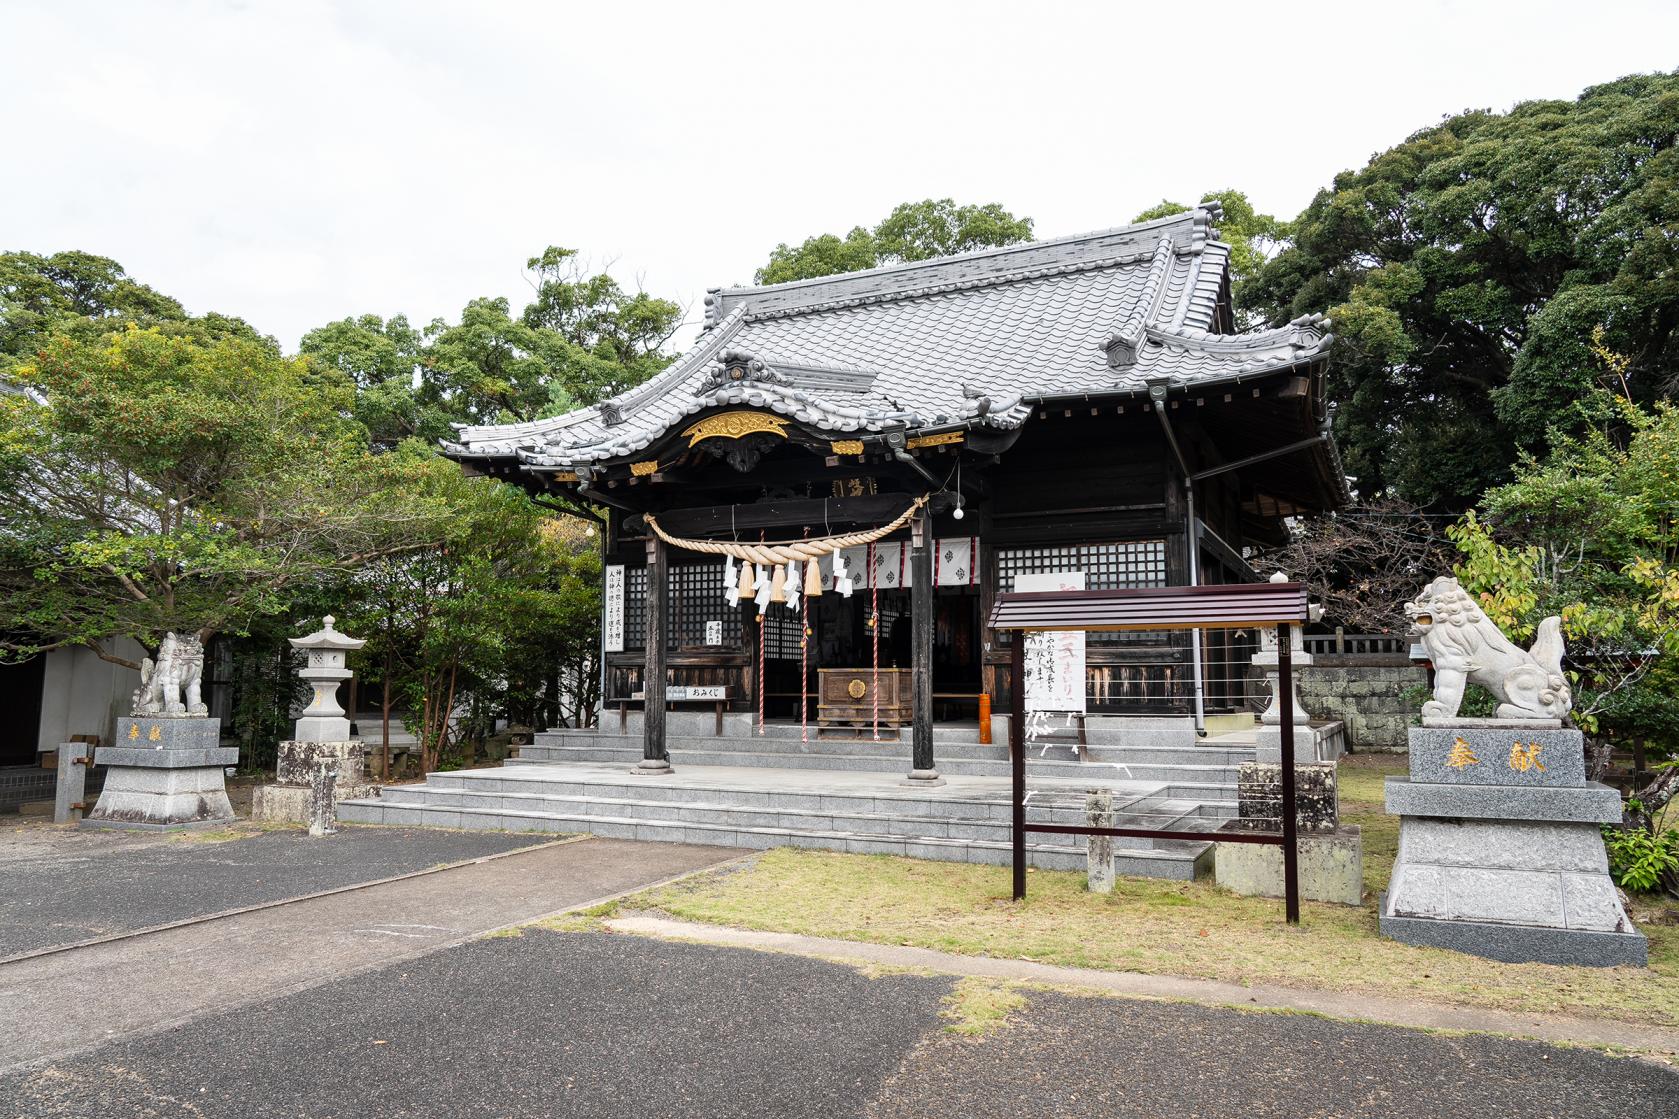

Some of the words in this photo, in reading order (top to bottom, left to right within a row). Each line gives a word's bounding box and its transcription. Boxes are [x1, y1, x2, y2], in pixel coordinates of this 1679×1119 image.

[692, 688, 719, 697] おみくじ
[1445, 737, 1547, 772] 奉献
